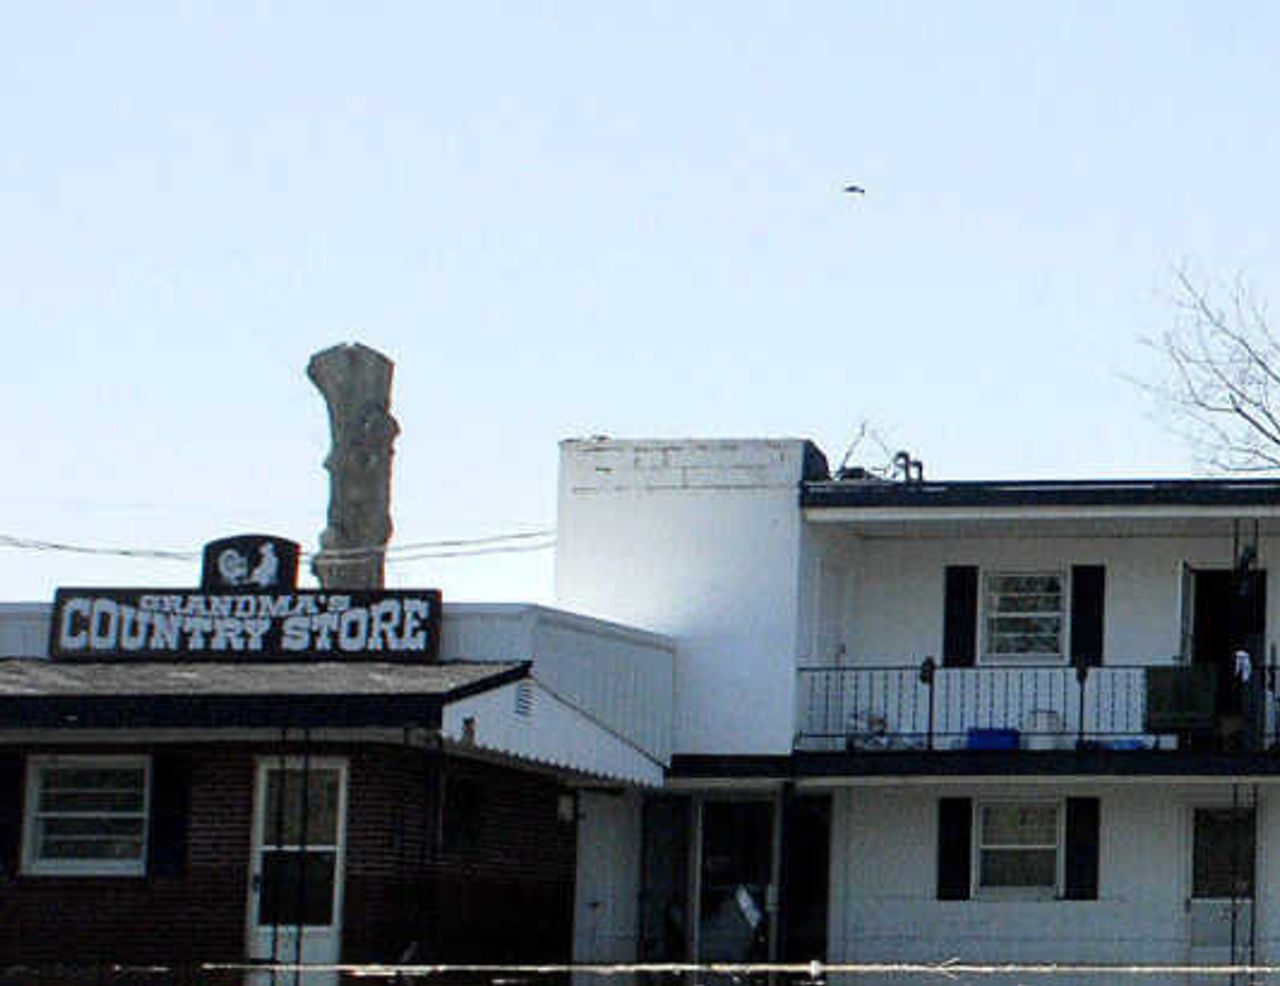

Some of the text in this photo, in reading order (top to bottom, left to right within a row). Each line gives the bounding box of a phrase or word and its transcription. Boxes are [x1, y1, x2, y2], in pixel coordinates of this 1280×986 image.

[139, 595, 351, 616] GRANDMA'S
[60, 598, 428, 650] COUNTRY STORE
